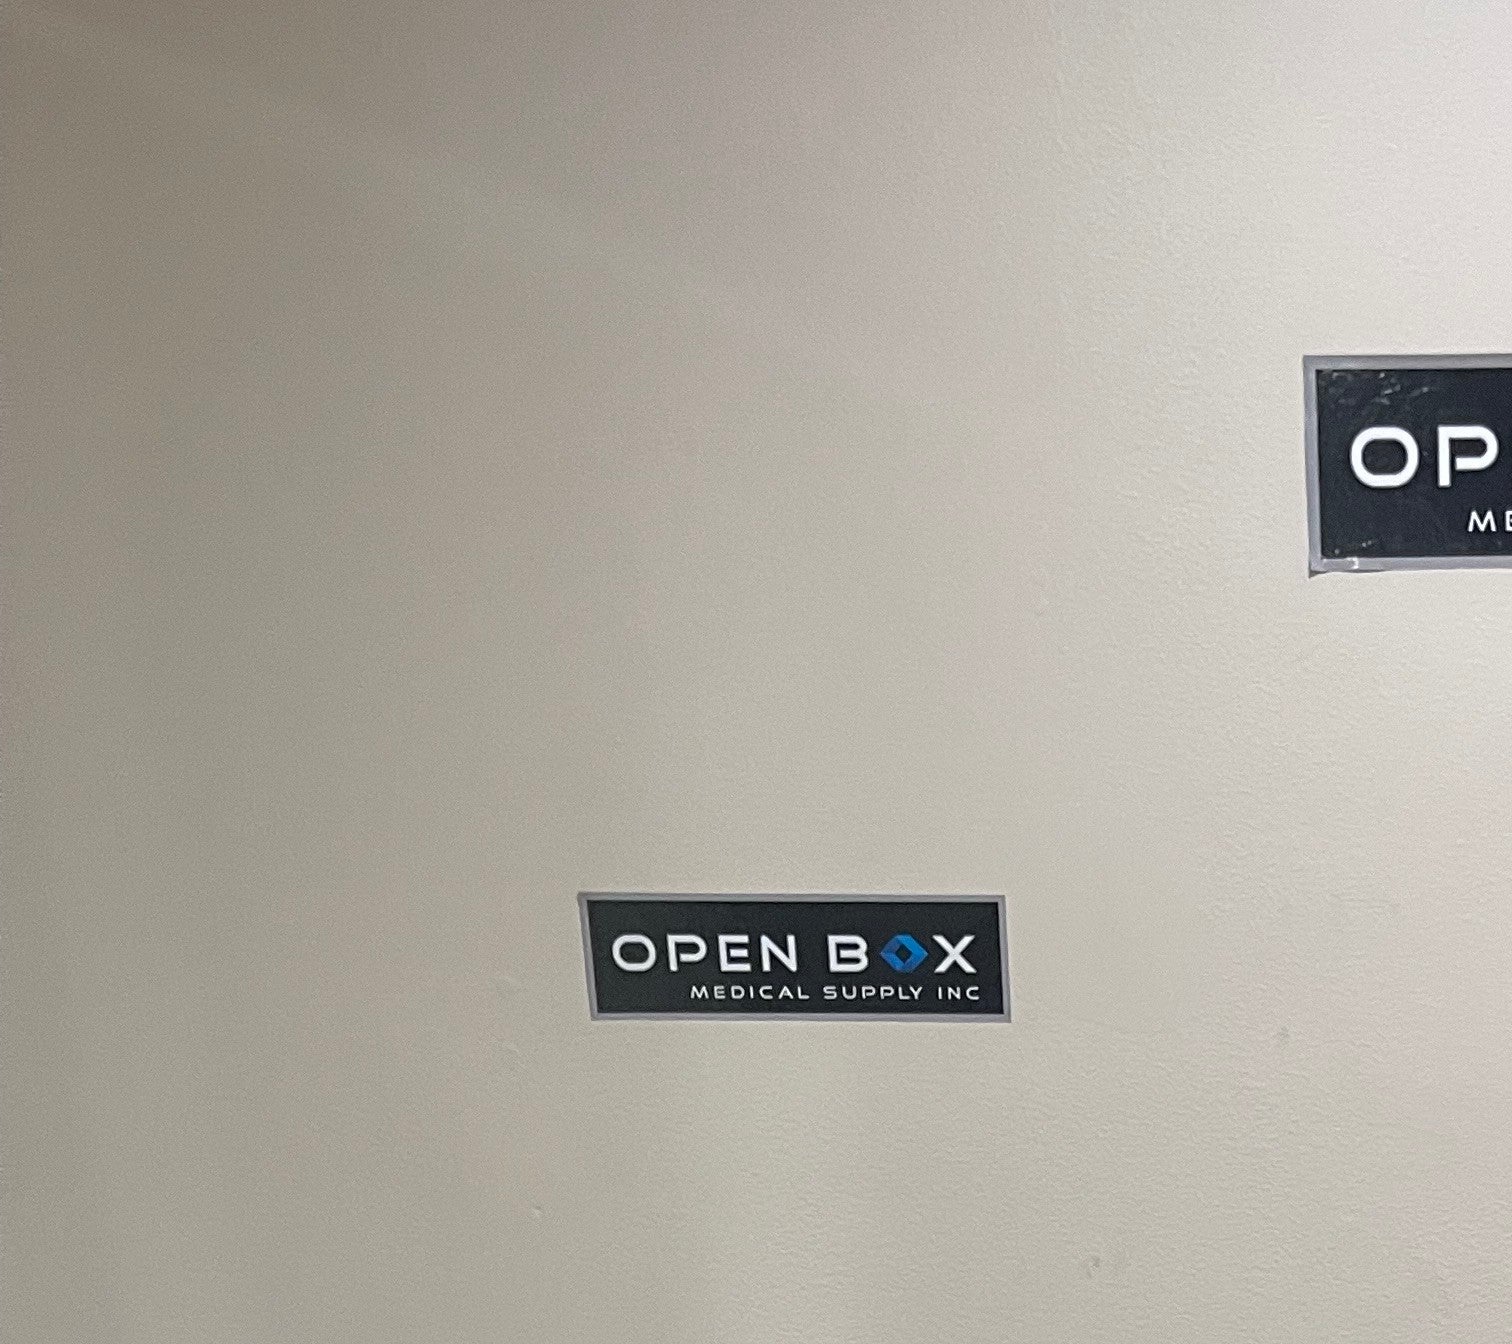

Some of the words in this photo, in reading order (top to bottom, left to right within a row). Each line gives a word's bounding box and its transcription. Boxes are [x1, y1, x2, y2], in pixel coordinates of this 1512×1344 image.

[612, 935, 797, 972] OPEN
[691, 986, 809, 999] MEDICAL
[823, 986, 922, 999] SUPPLY
[939, 987, 979, 1000] INC
